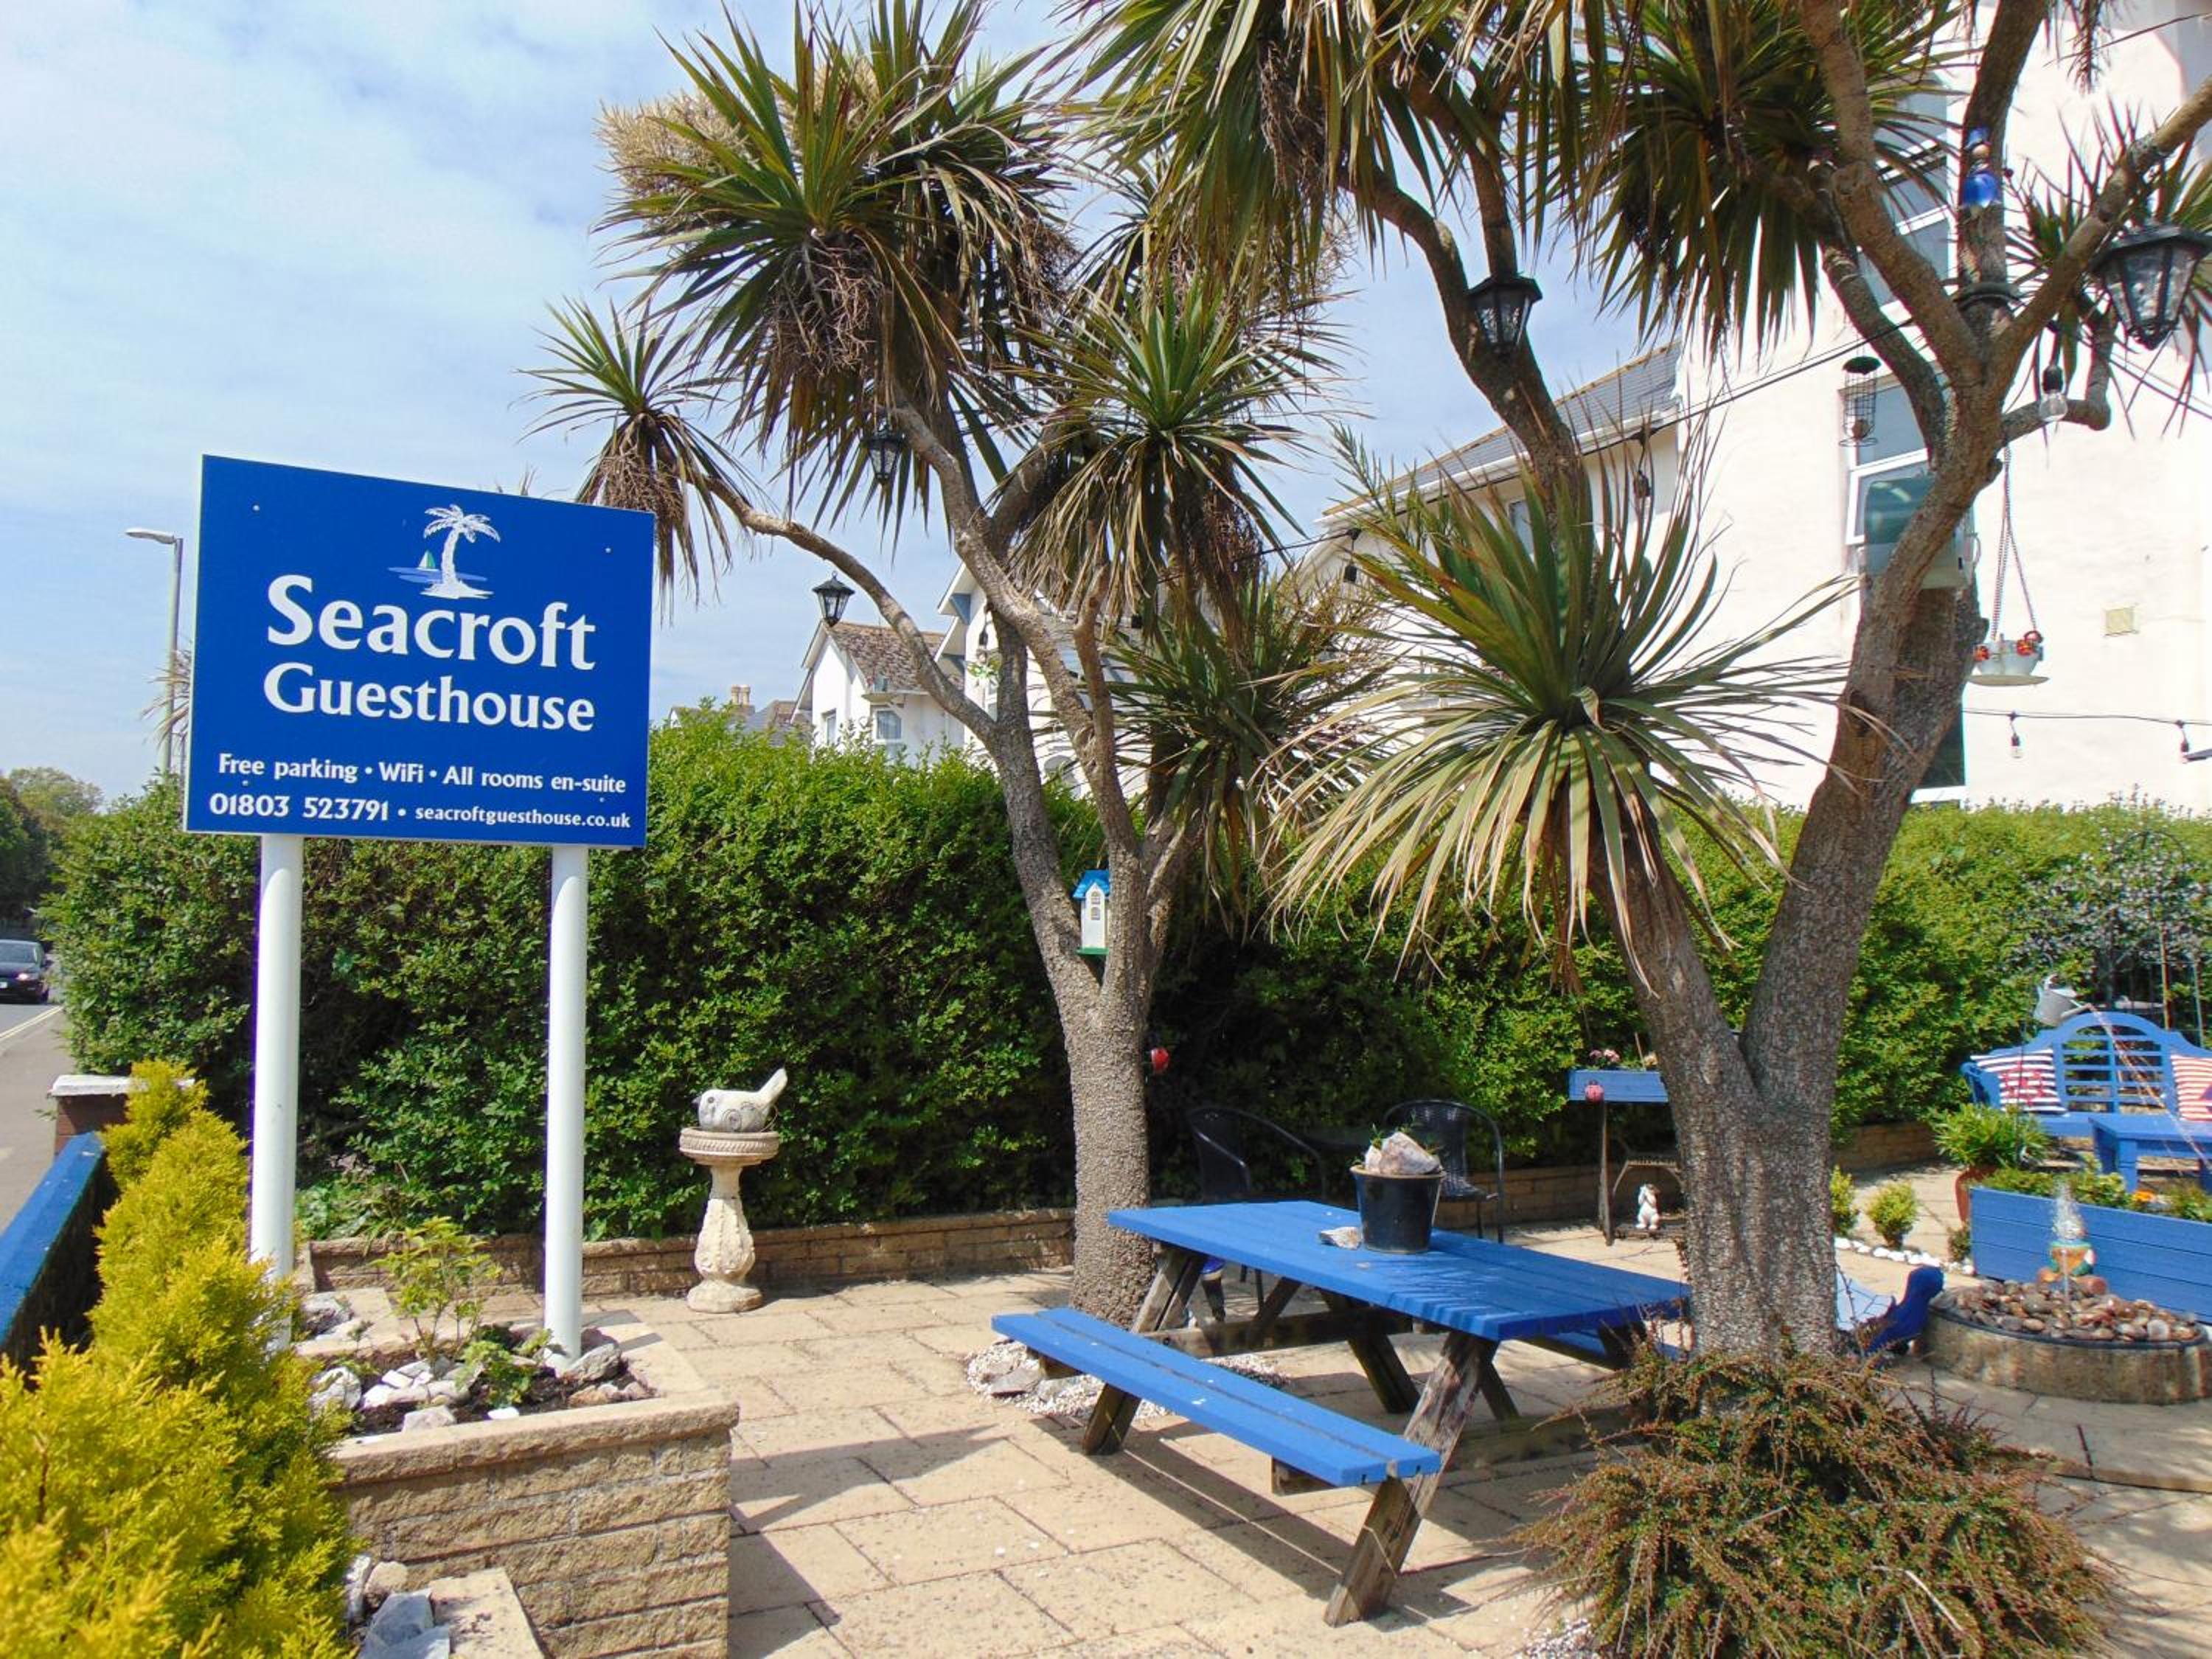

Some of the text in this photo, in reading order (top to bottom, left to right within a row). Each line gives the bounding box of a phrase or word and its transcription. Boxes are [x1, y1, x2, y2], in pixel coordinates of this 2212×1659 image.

[267, 574, 597, 670] Seacroft
[263, 661, 595, 732] Guesthouse
[218, 753, 627, 793] Free parking WiFi All rooms en-suite
[209, 793, 631, 828] 01803 523791 seacroftguesthouse.co.uk
